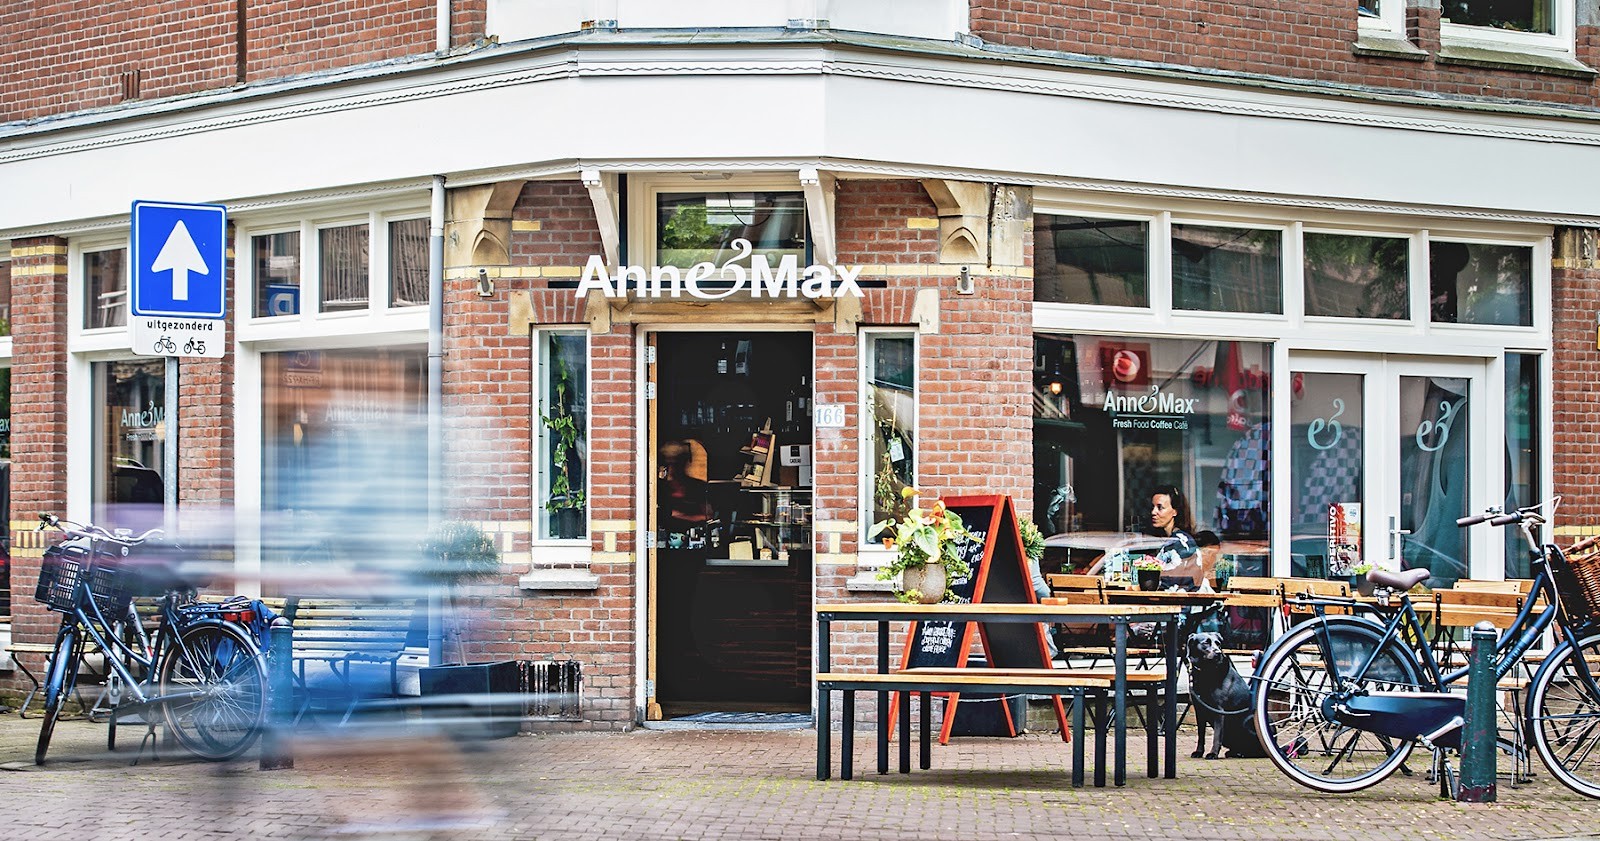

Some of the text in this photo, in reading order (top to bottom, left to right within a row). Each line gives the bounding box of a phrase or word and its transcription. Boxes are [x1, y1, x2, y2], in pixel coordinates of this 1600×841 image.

[147, 320, 213, 332] uitgezonderd
[816, 408, 842, 425] 166
[1113, 419, 1132, 428] Fresh
[1133, 420, 1150, 429] Food
[1150, 420, 1173, 430] Coffee
[1329, 506, 1338, 574] APERITIVO
